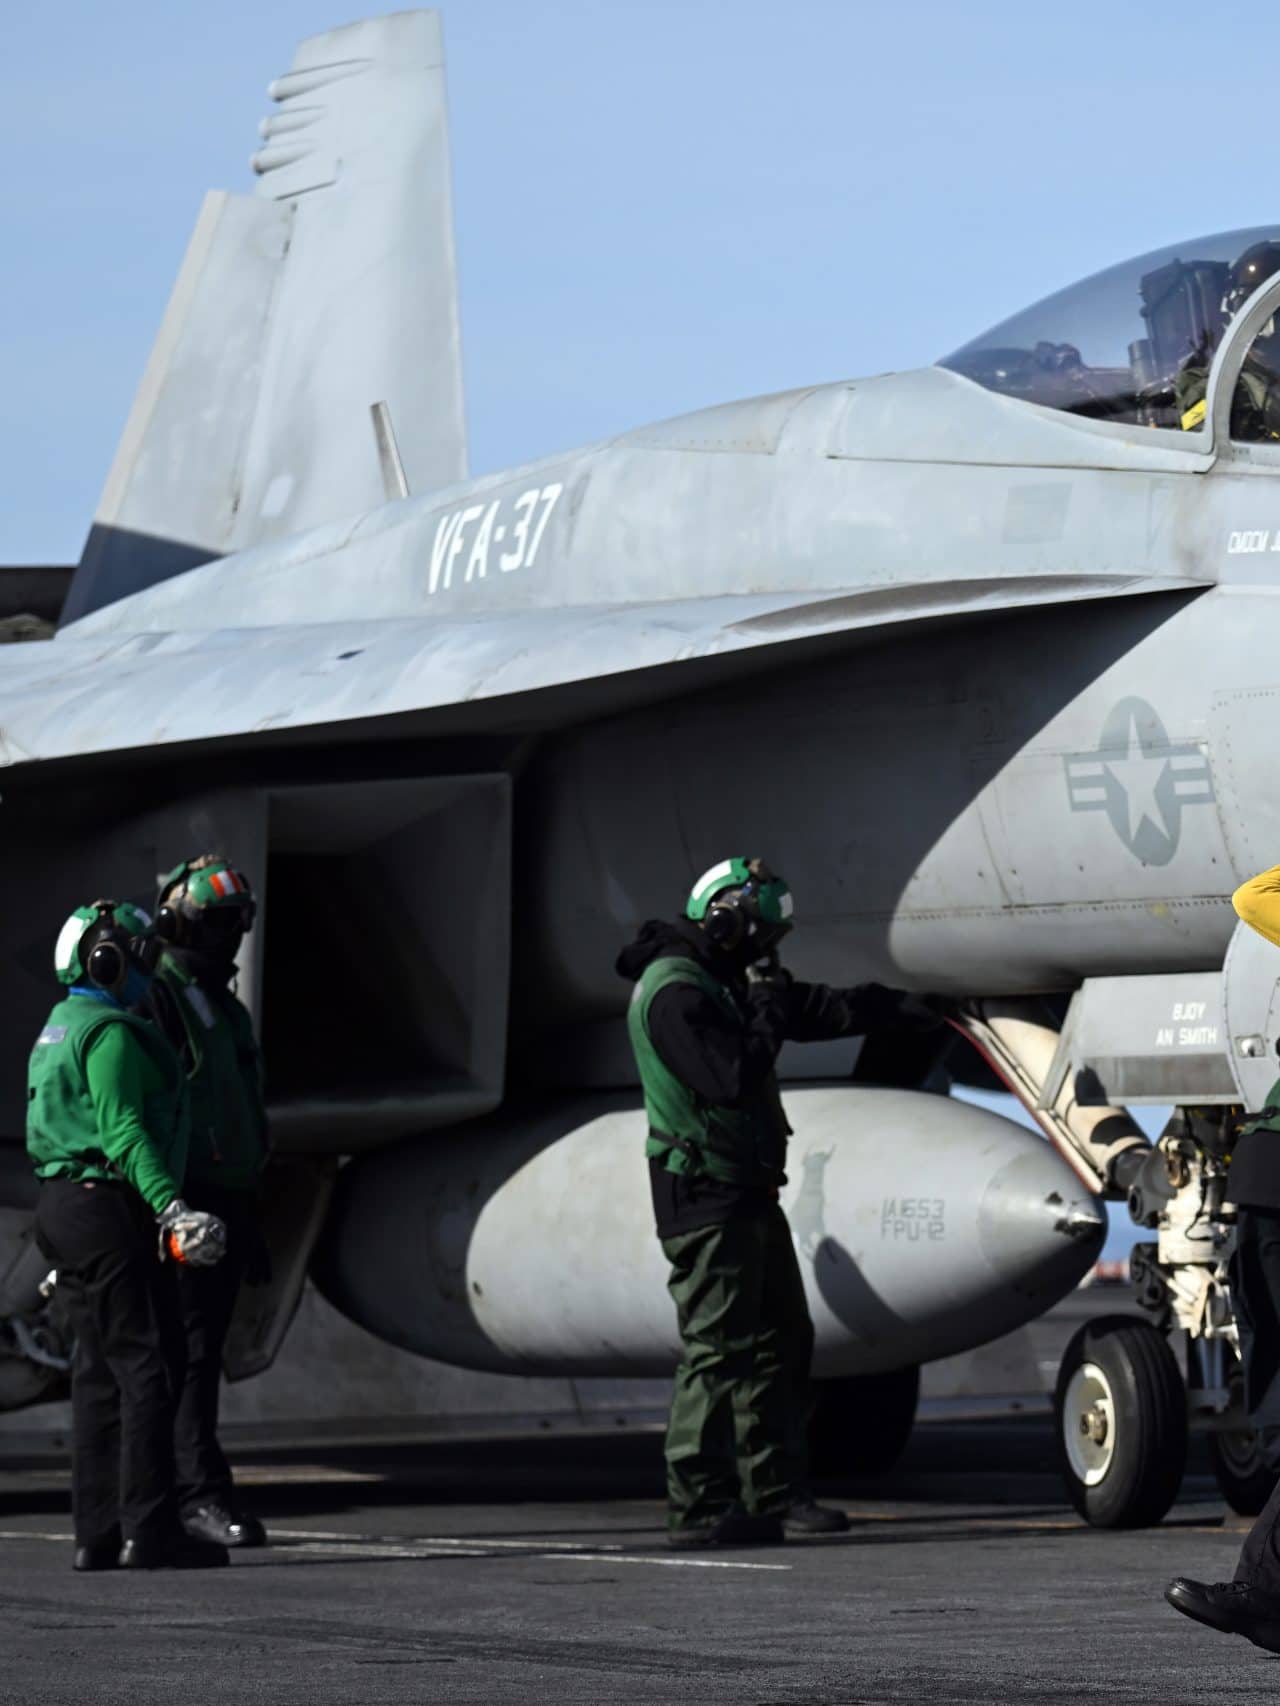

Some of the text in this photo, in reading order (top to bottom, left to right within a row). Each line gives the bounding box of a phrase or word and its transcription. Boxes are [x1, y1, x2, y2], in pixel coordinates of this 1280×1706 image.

[428, 483, 563, 595] VFA-37
[1155, 1027, 1217, 1047] AN SMITH
